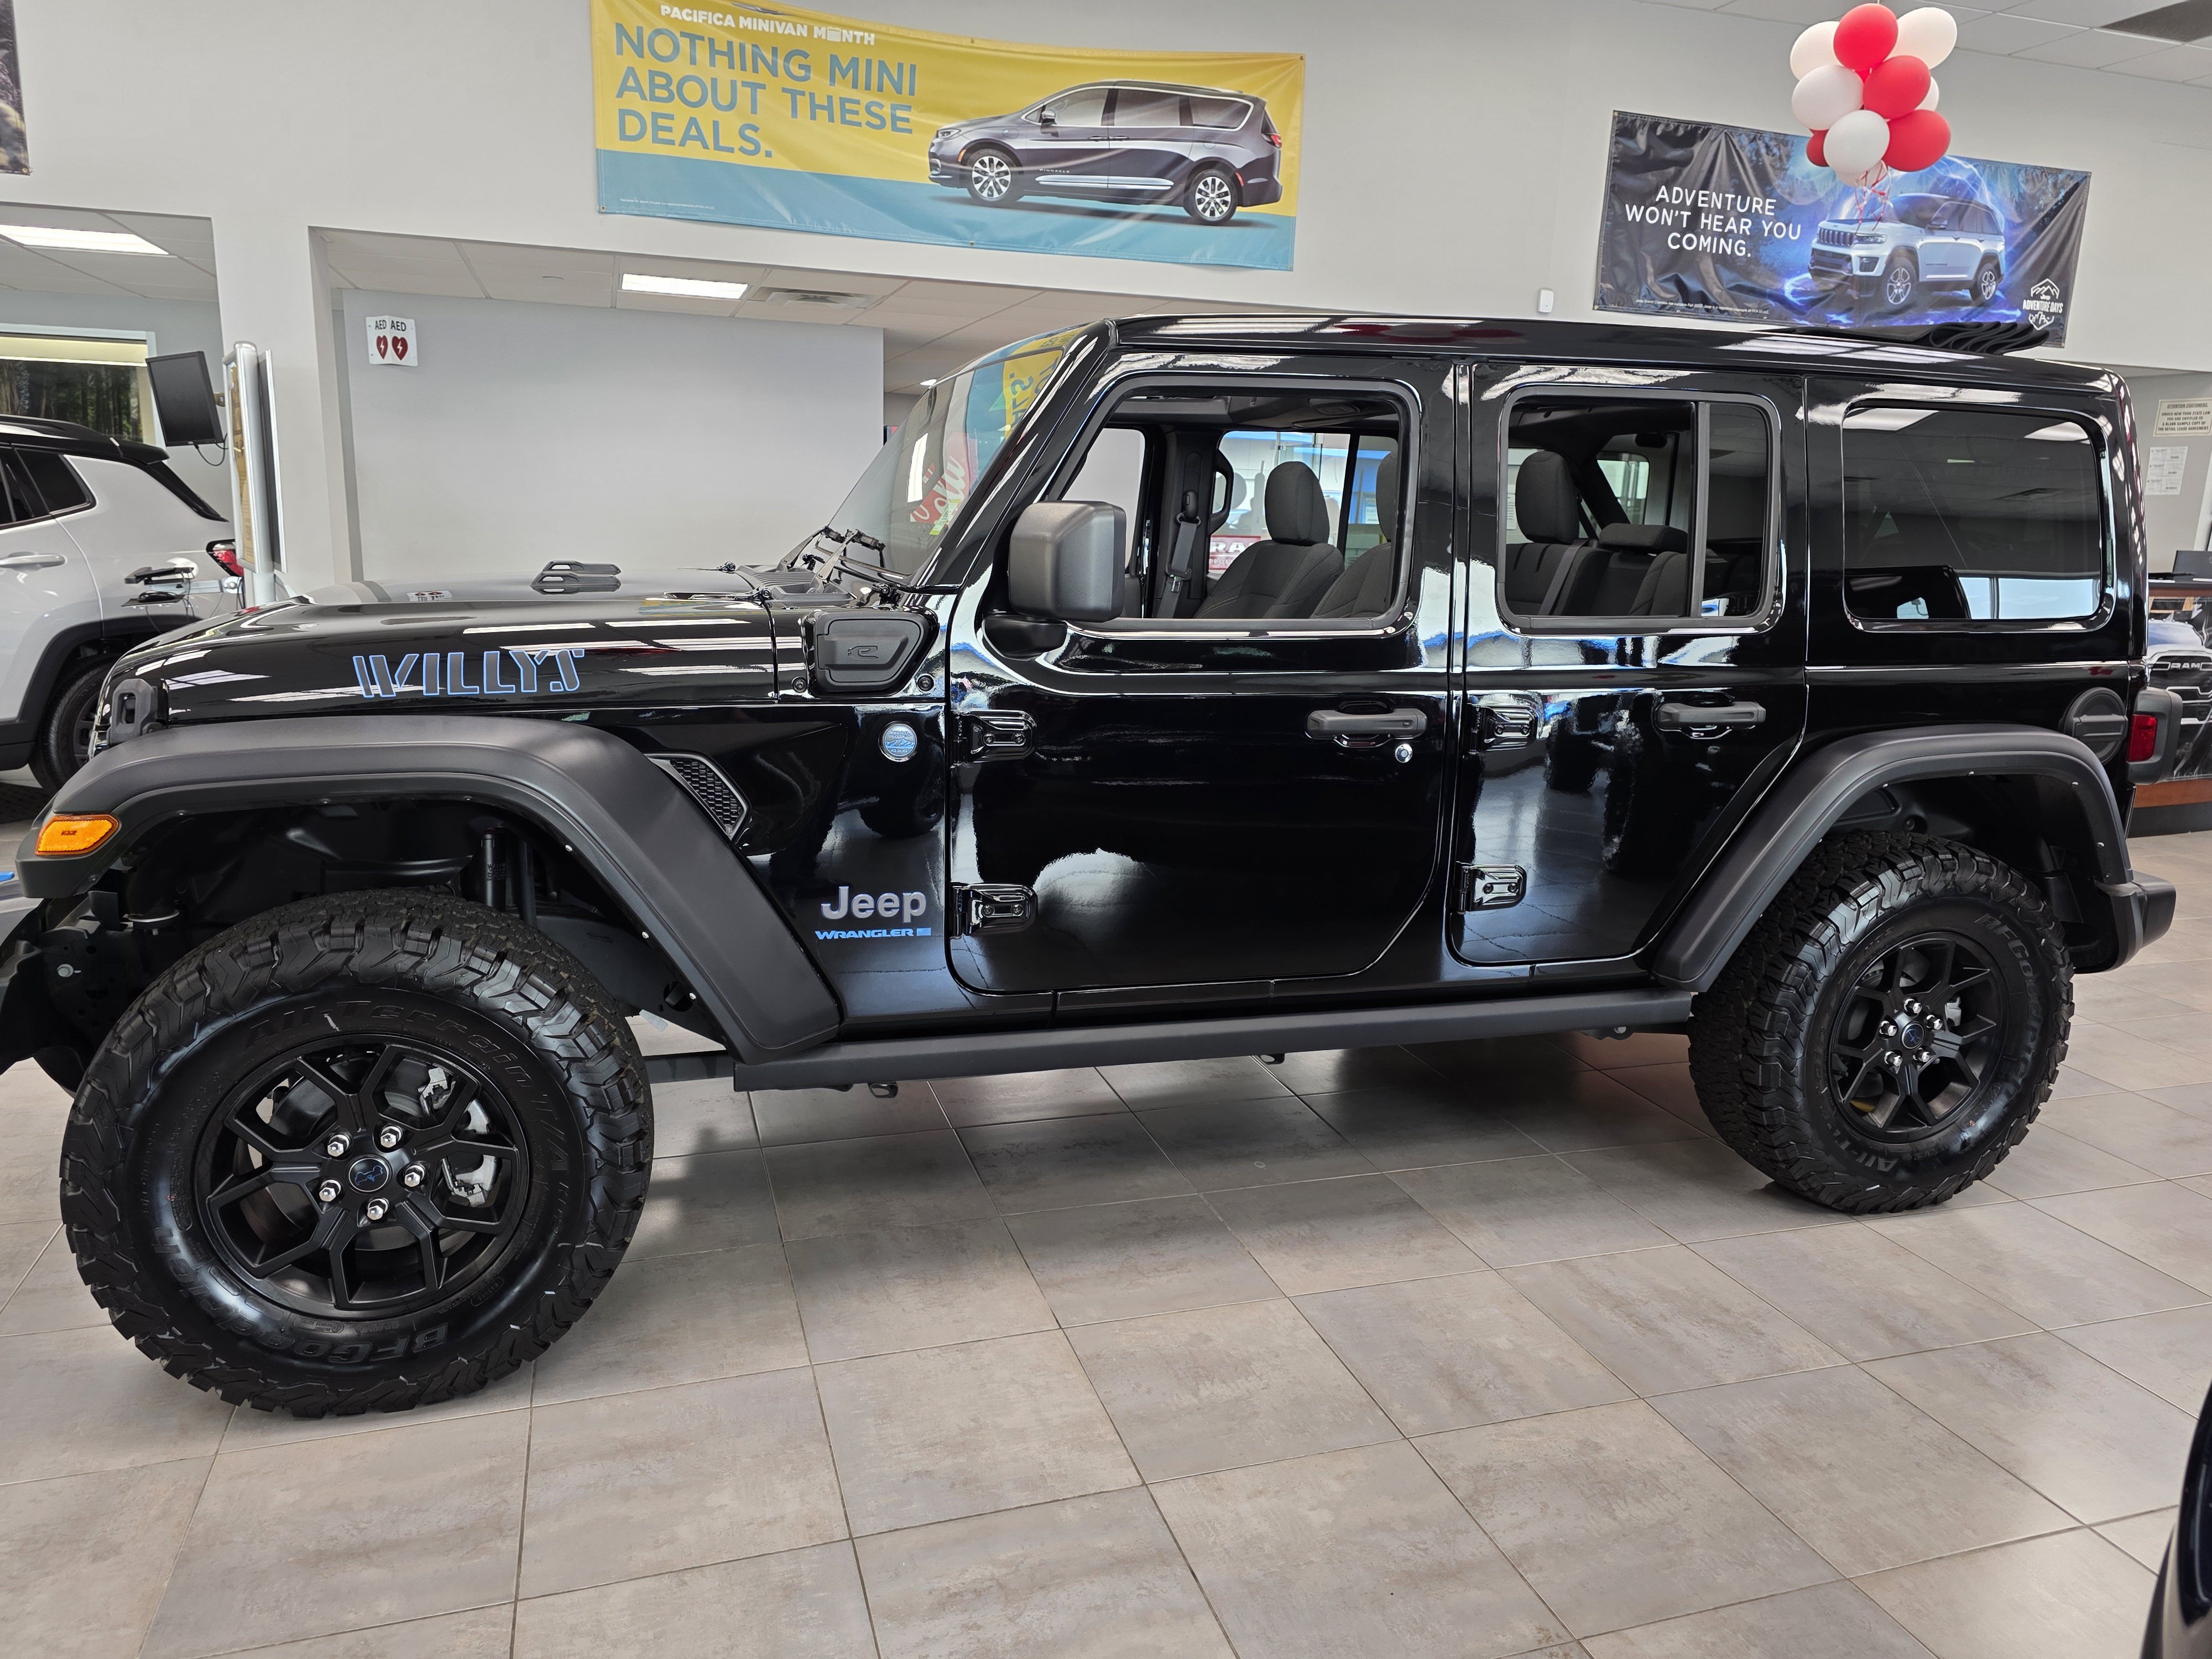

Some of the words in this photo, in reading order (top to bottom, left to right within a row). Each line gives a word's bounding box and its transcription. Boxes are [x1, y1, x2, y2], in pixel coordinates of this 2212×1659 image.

[661, 5, 735, 28] PACIFICA
[739, 17, 808, 38] MINIVAN
[615, 22, 811, 82] NOTHING
[830, 54, 917, 96] MINI
[615, 66, 766, 115] ABOUT
[781, 87, 914, 134] THESE
[618, 108, 773, 158] DEALS.
[1655, 185, 1777, 216] ADVENTURE
[1625, 204, 1691, 228] WON'T
[1701, 212, 1752, 235] HEAR
[1762, 220, 1801, 239] YOU
[1668, 232, 1751, 257] COMING.
[2023, 299, 2051, 312] ADVENTURE
[2049, 302, 2063, 313] DAYS
[375, 320, 387, 330] AED
[390, 320, 406, 331] AED
[1211, 542, 1255, 553] RA
[352, 649, 586, 698] WILLYS
[821, 886, 926, 923] Jeep
[815, 928, 914, 940] WRANGLER
[1975, 912, 2042, 1100] BFGoodrich
[152, 1227, 449, 1363] BFGoodrich
